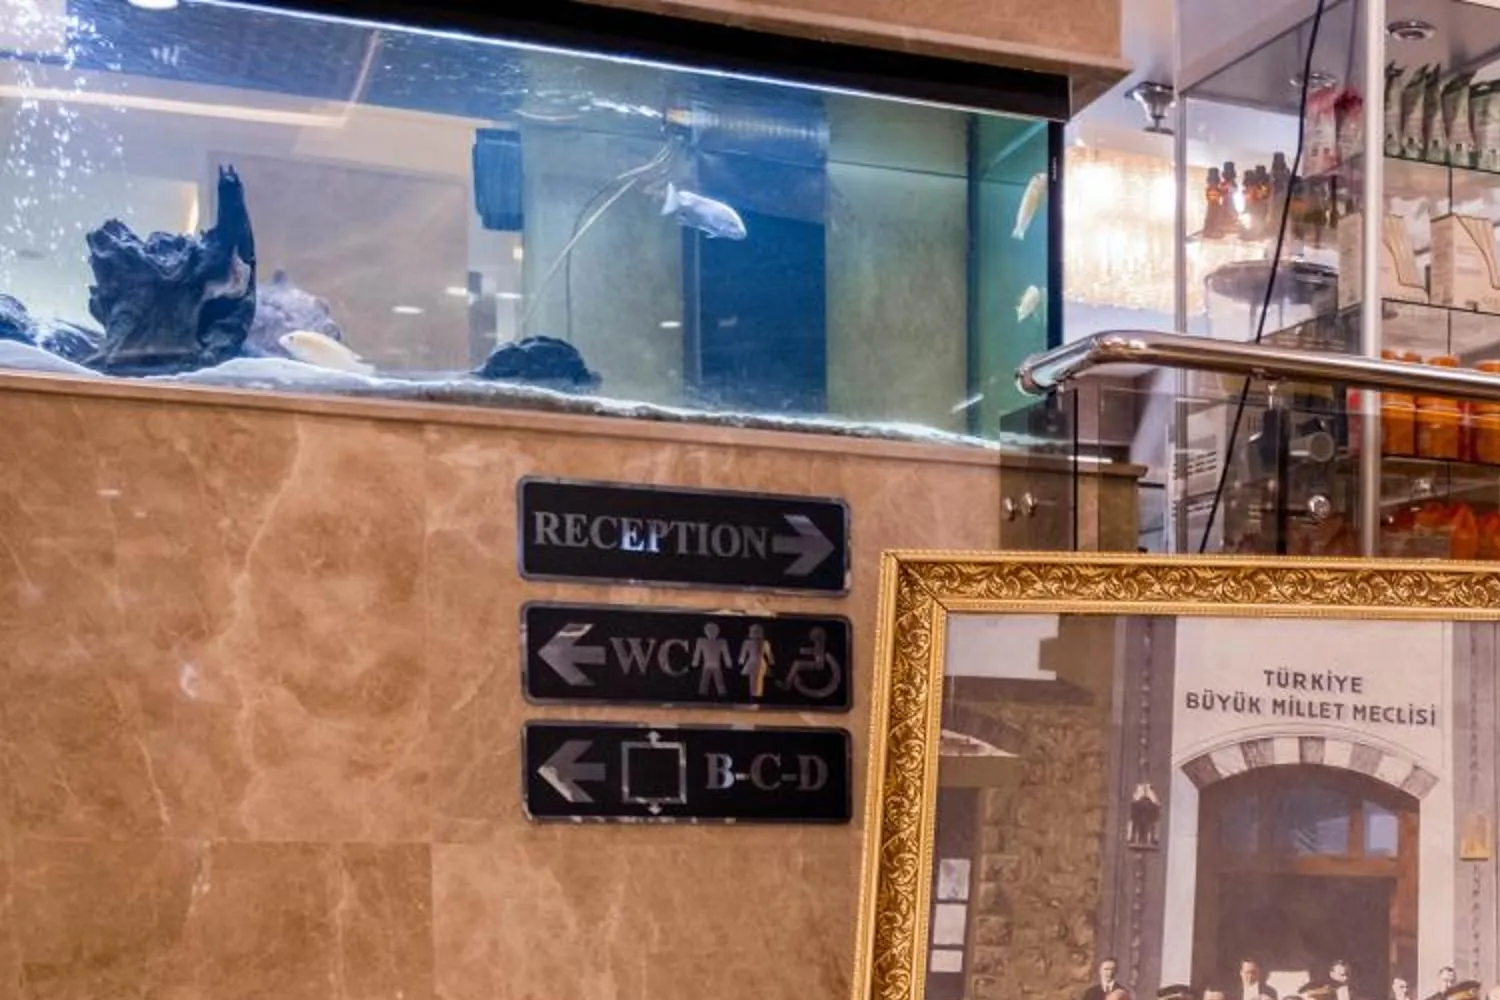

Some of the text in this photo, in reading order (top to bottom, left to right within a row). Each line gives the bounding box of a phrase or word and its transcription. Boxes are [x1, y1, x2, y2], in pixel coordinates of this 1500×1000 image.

[532, 511, 768, 558] RECEPTION
[610, 637, 690, 676] WC
[1263, 667, 1364, 694] TÜRKİYE
[1186, 689, 1436, 727] BÜYÜK MİLLET MECLİSİ
[705, 753, 828, 791] B-C-D
